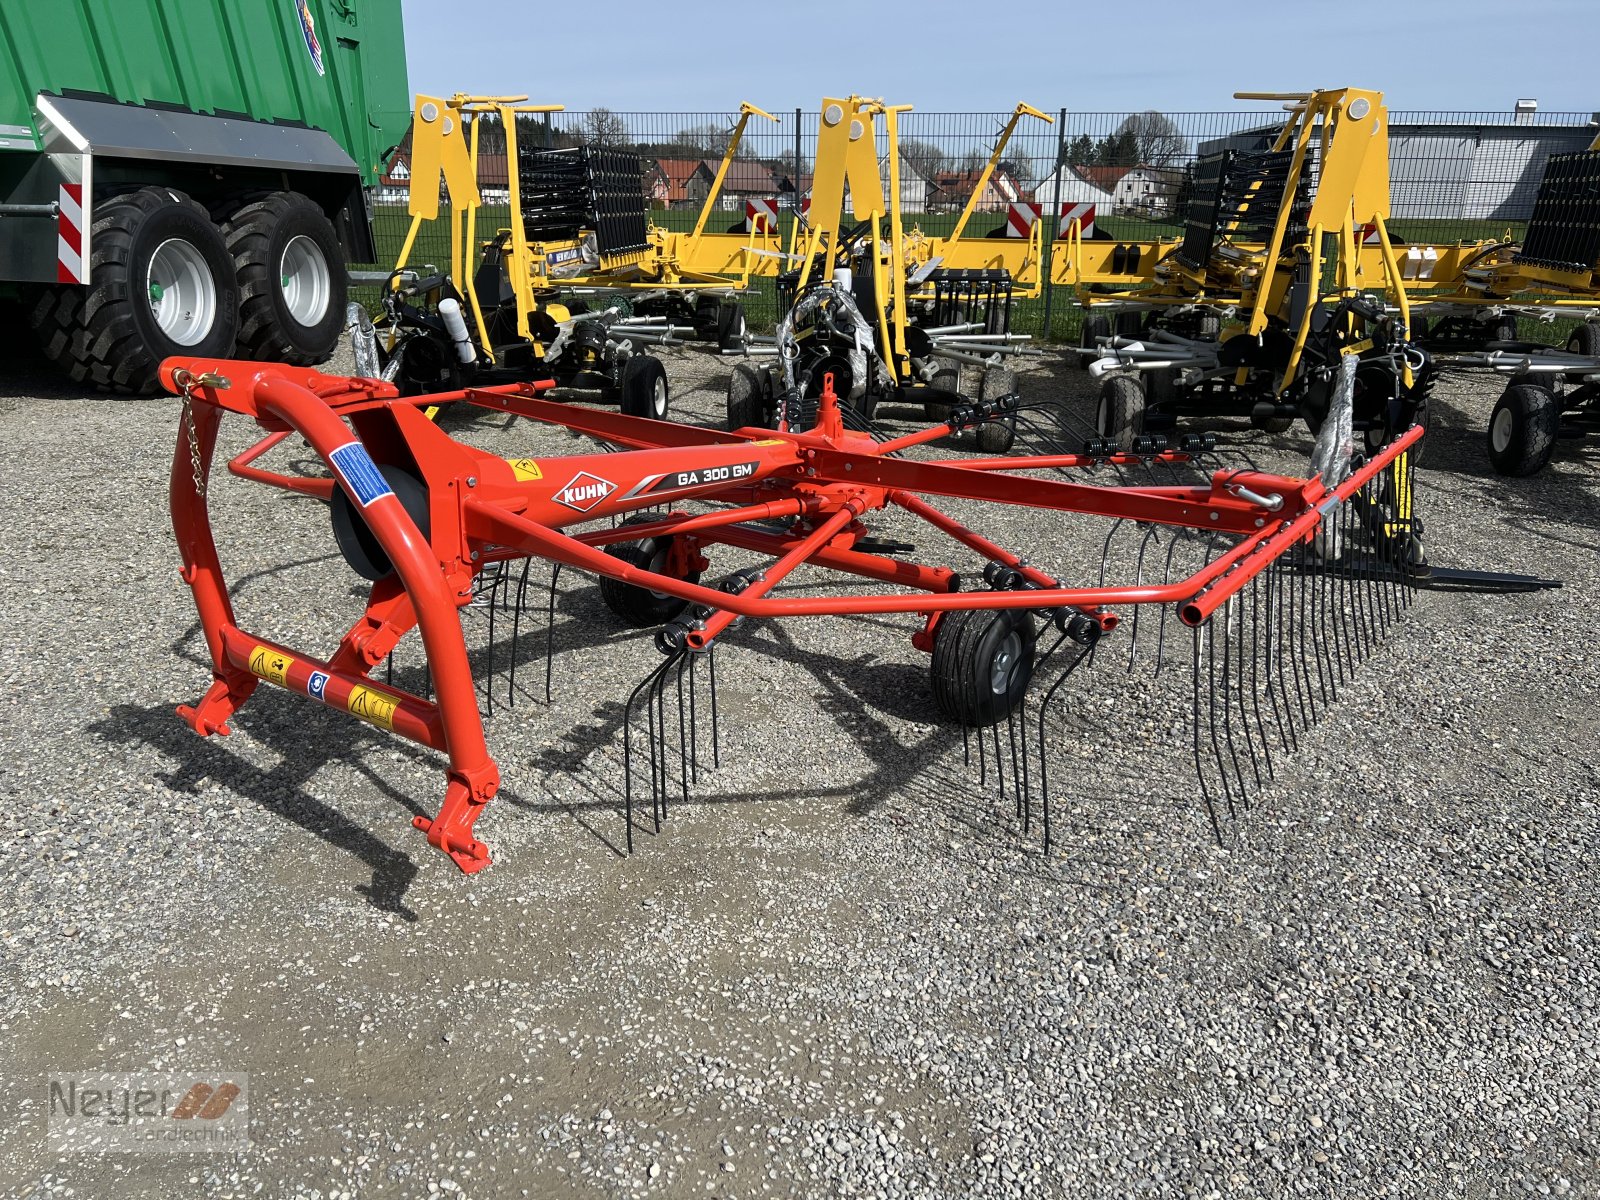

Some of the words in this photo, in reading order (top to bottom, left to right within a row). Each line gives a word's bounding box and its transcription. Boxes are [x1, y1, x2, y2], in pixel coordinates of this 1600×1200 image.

[678, 472, 698, 486] GA
[703, 468, 728, 482] 300
[733, 464, 752, 477] GM
[564, 483, 607, 503] KUHN
